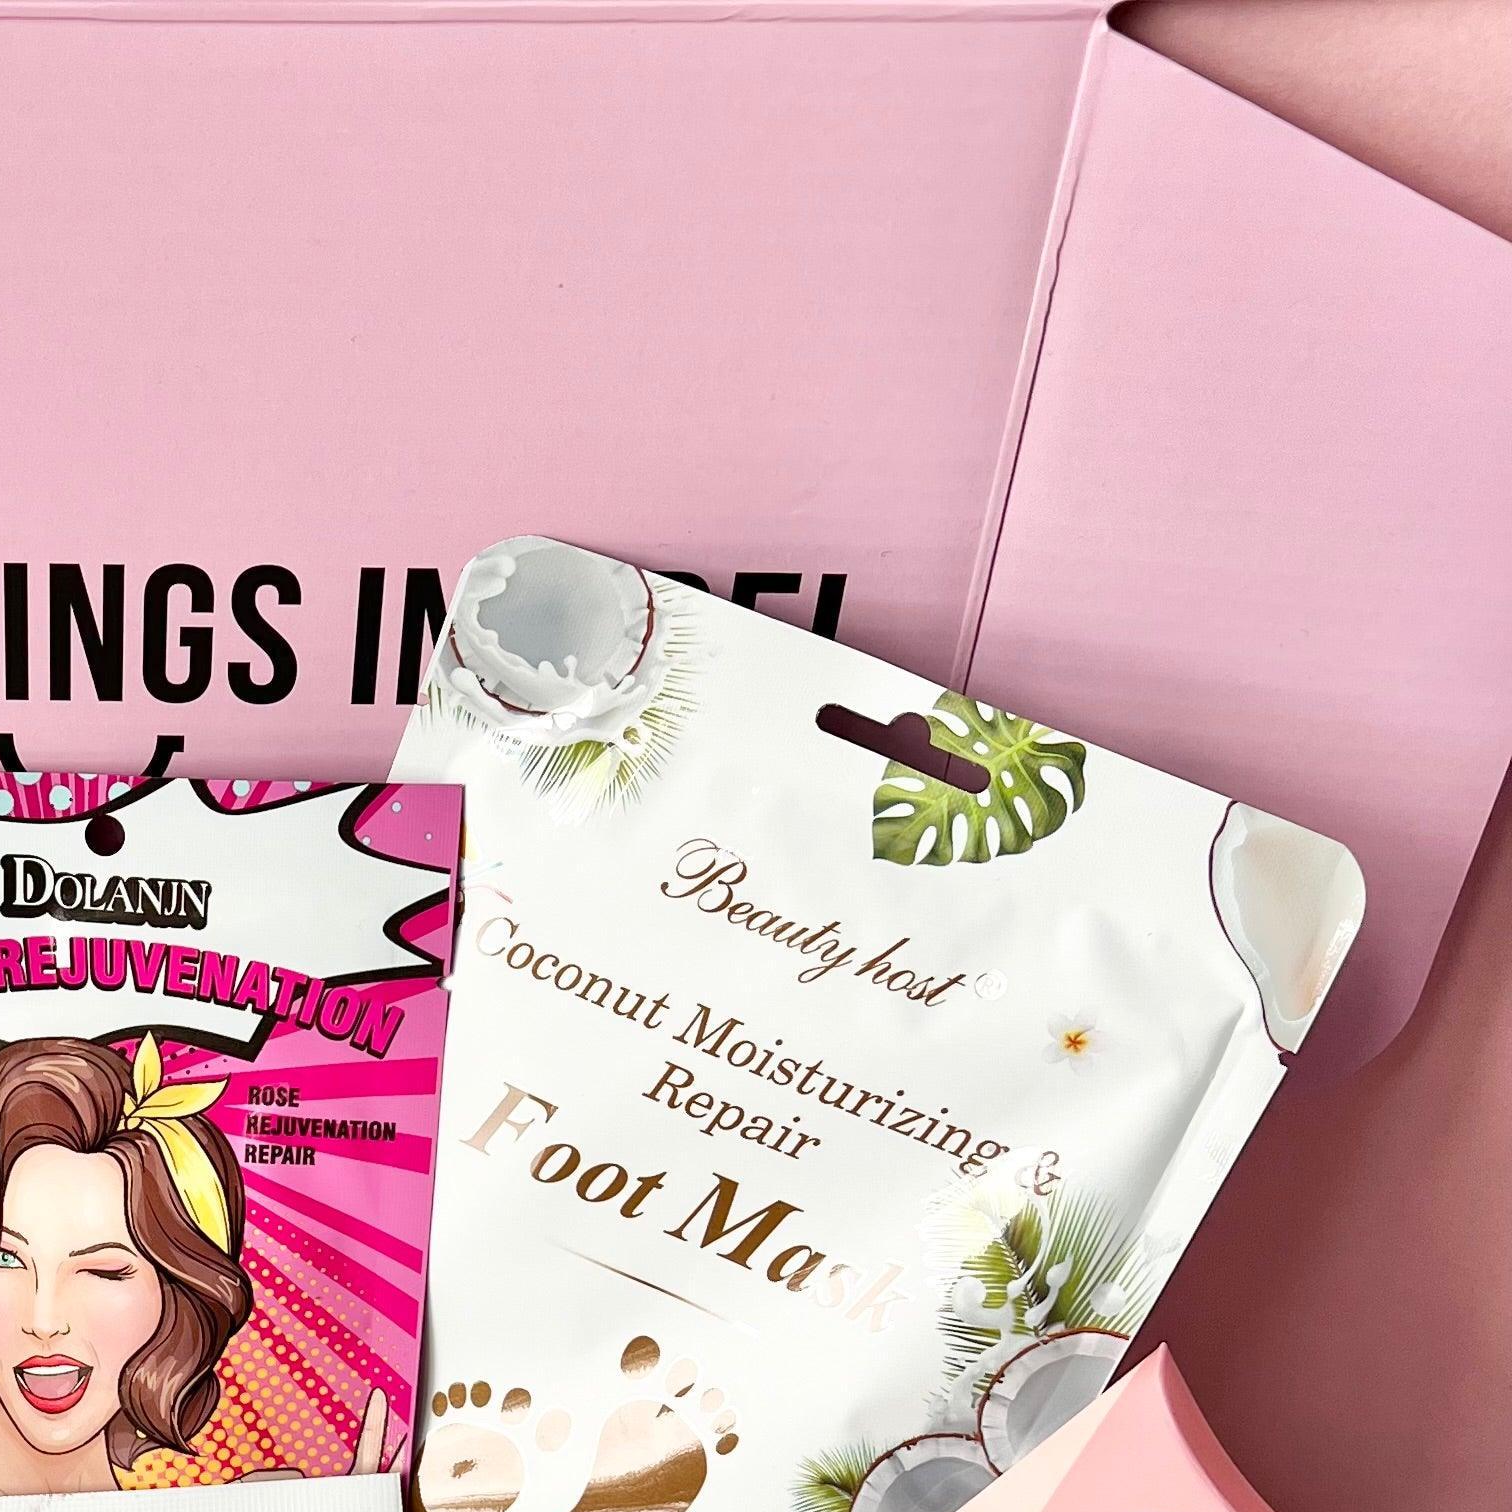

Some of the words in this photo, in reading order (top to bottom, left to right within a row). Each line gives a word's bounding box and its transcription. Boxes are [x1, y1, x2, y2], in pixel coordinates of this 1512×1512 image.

[660, 838, 857, 983] Beauty
[854, 937, 966, 1007] host
[248, 1085, 300, 1109] ROSE
[475, 916, 670, 1030] Coconut
[672, 1002, 1010, 1179] Moisturizing
[244, 1144, 316, 1167] REPAIR
[246, 1114, 397, 1142] REJUVENATION
[642, 1061, 821, 1161] Repair
[459, 1080, 669, 1220] Foot
[664, 1172, 915, 1333] Mask
